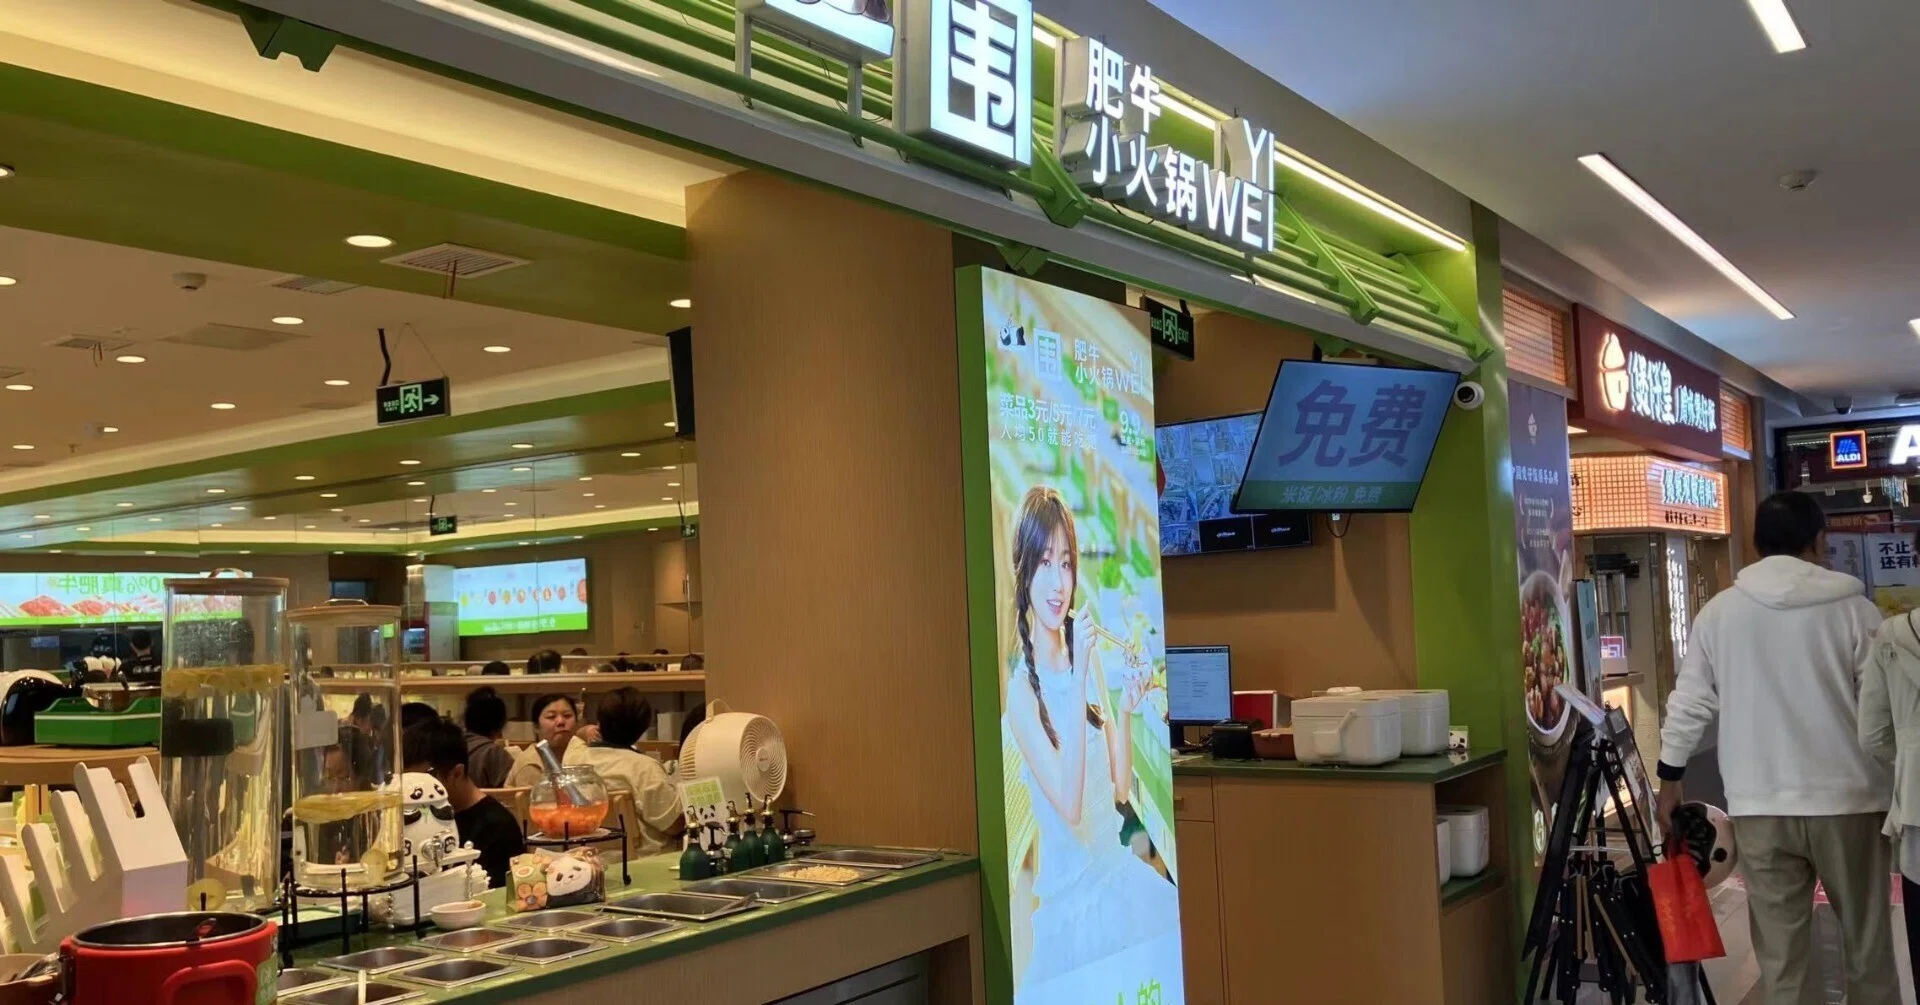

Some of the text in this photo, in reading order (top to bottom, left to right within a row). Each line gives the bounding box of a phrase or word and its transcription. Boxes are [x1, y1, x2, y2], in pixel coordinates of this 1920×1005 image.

[1086, 39, 1161, 134] 肥牛
[1241, 118, 1275, 194] YI
[1074, 339, 1100, 363] 肥牛
[1277, 379, 1428, 469] 免费
[1836, 453, 1861, 462] ALDI
[1878, 540, 1911, 556] 不止
